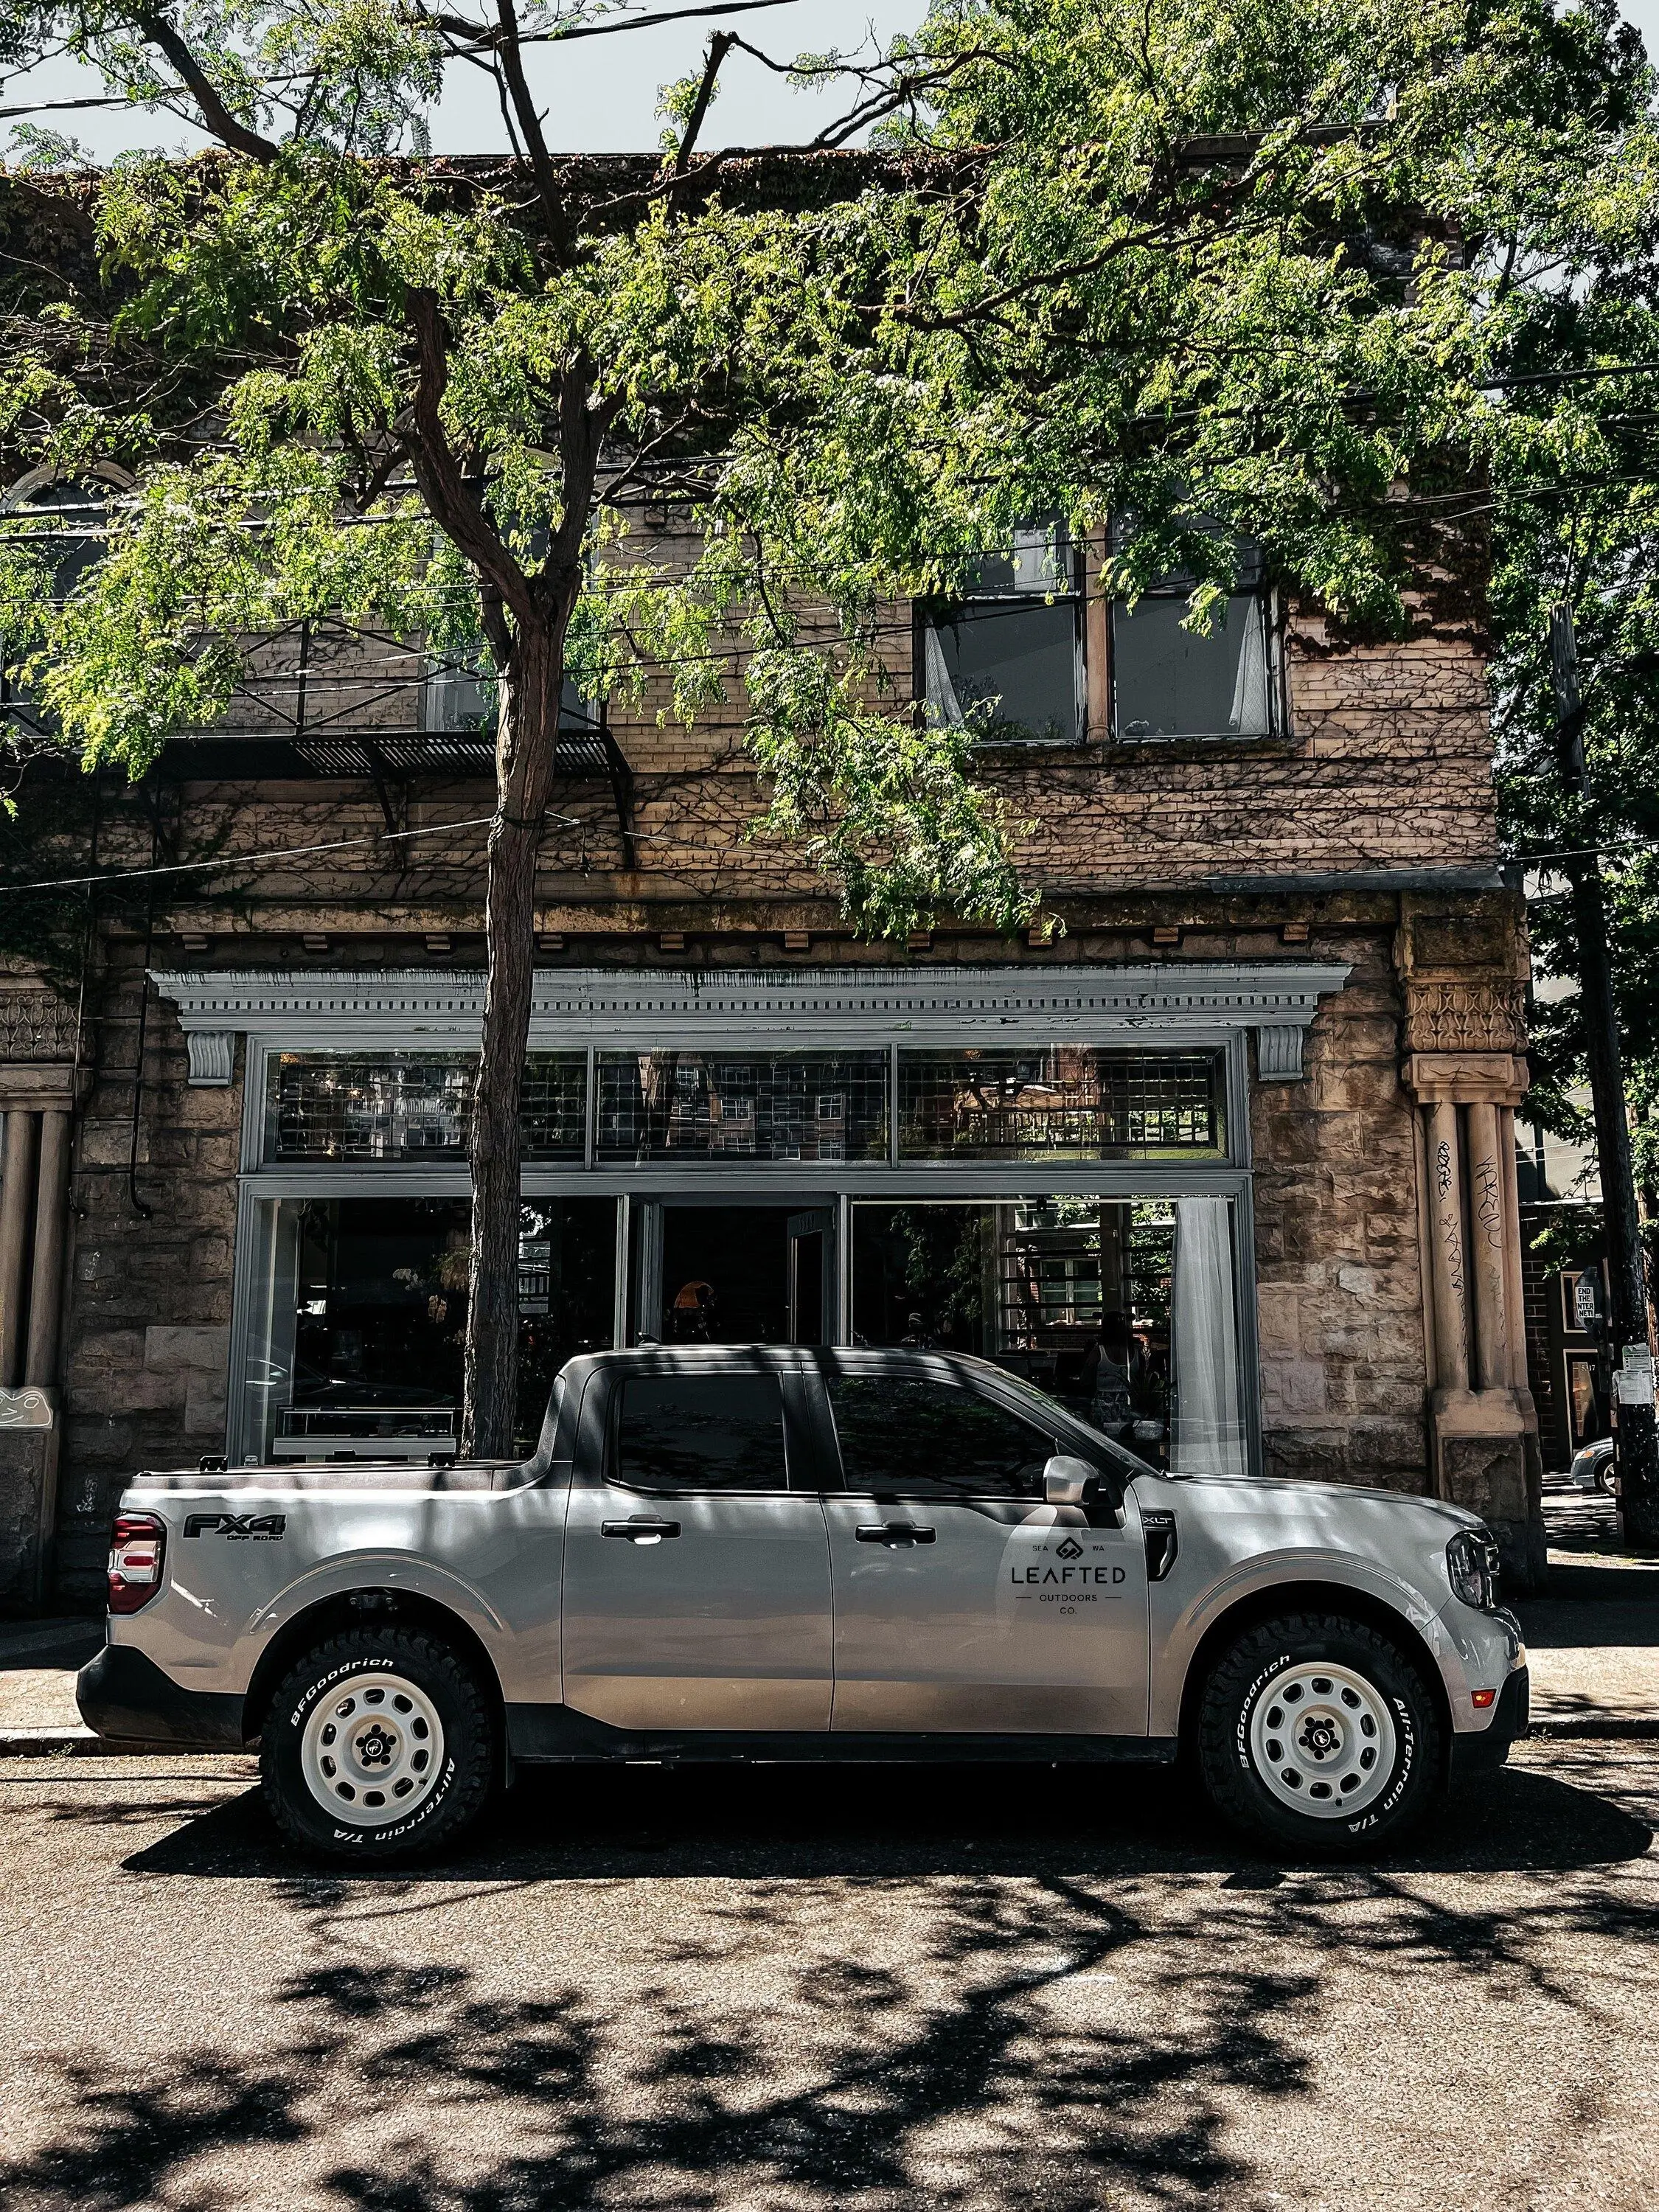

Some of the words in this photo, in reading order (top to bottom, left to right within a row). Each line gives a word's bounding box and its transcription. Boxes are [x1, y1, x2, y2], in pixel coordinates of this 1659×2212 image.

[182, 1512, 287, 1539] FX4
[1011, 1567, 1126, 1584] LEAFTED
[1060, 1607, 1077, 1615] CO.
[291, 1658, 394, 1727] BFGoodrich
[1237, 1654, 1290, 1769] BFGoodrich
[1382, 1697, 1415, 1811] All-Terrain
[375, 1757, 456, 1840] All-Terrain
[333, 1829, 364, 1843] T/A
[1348, 1814, 1379, 1833] T/A
